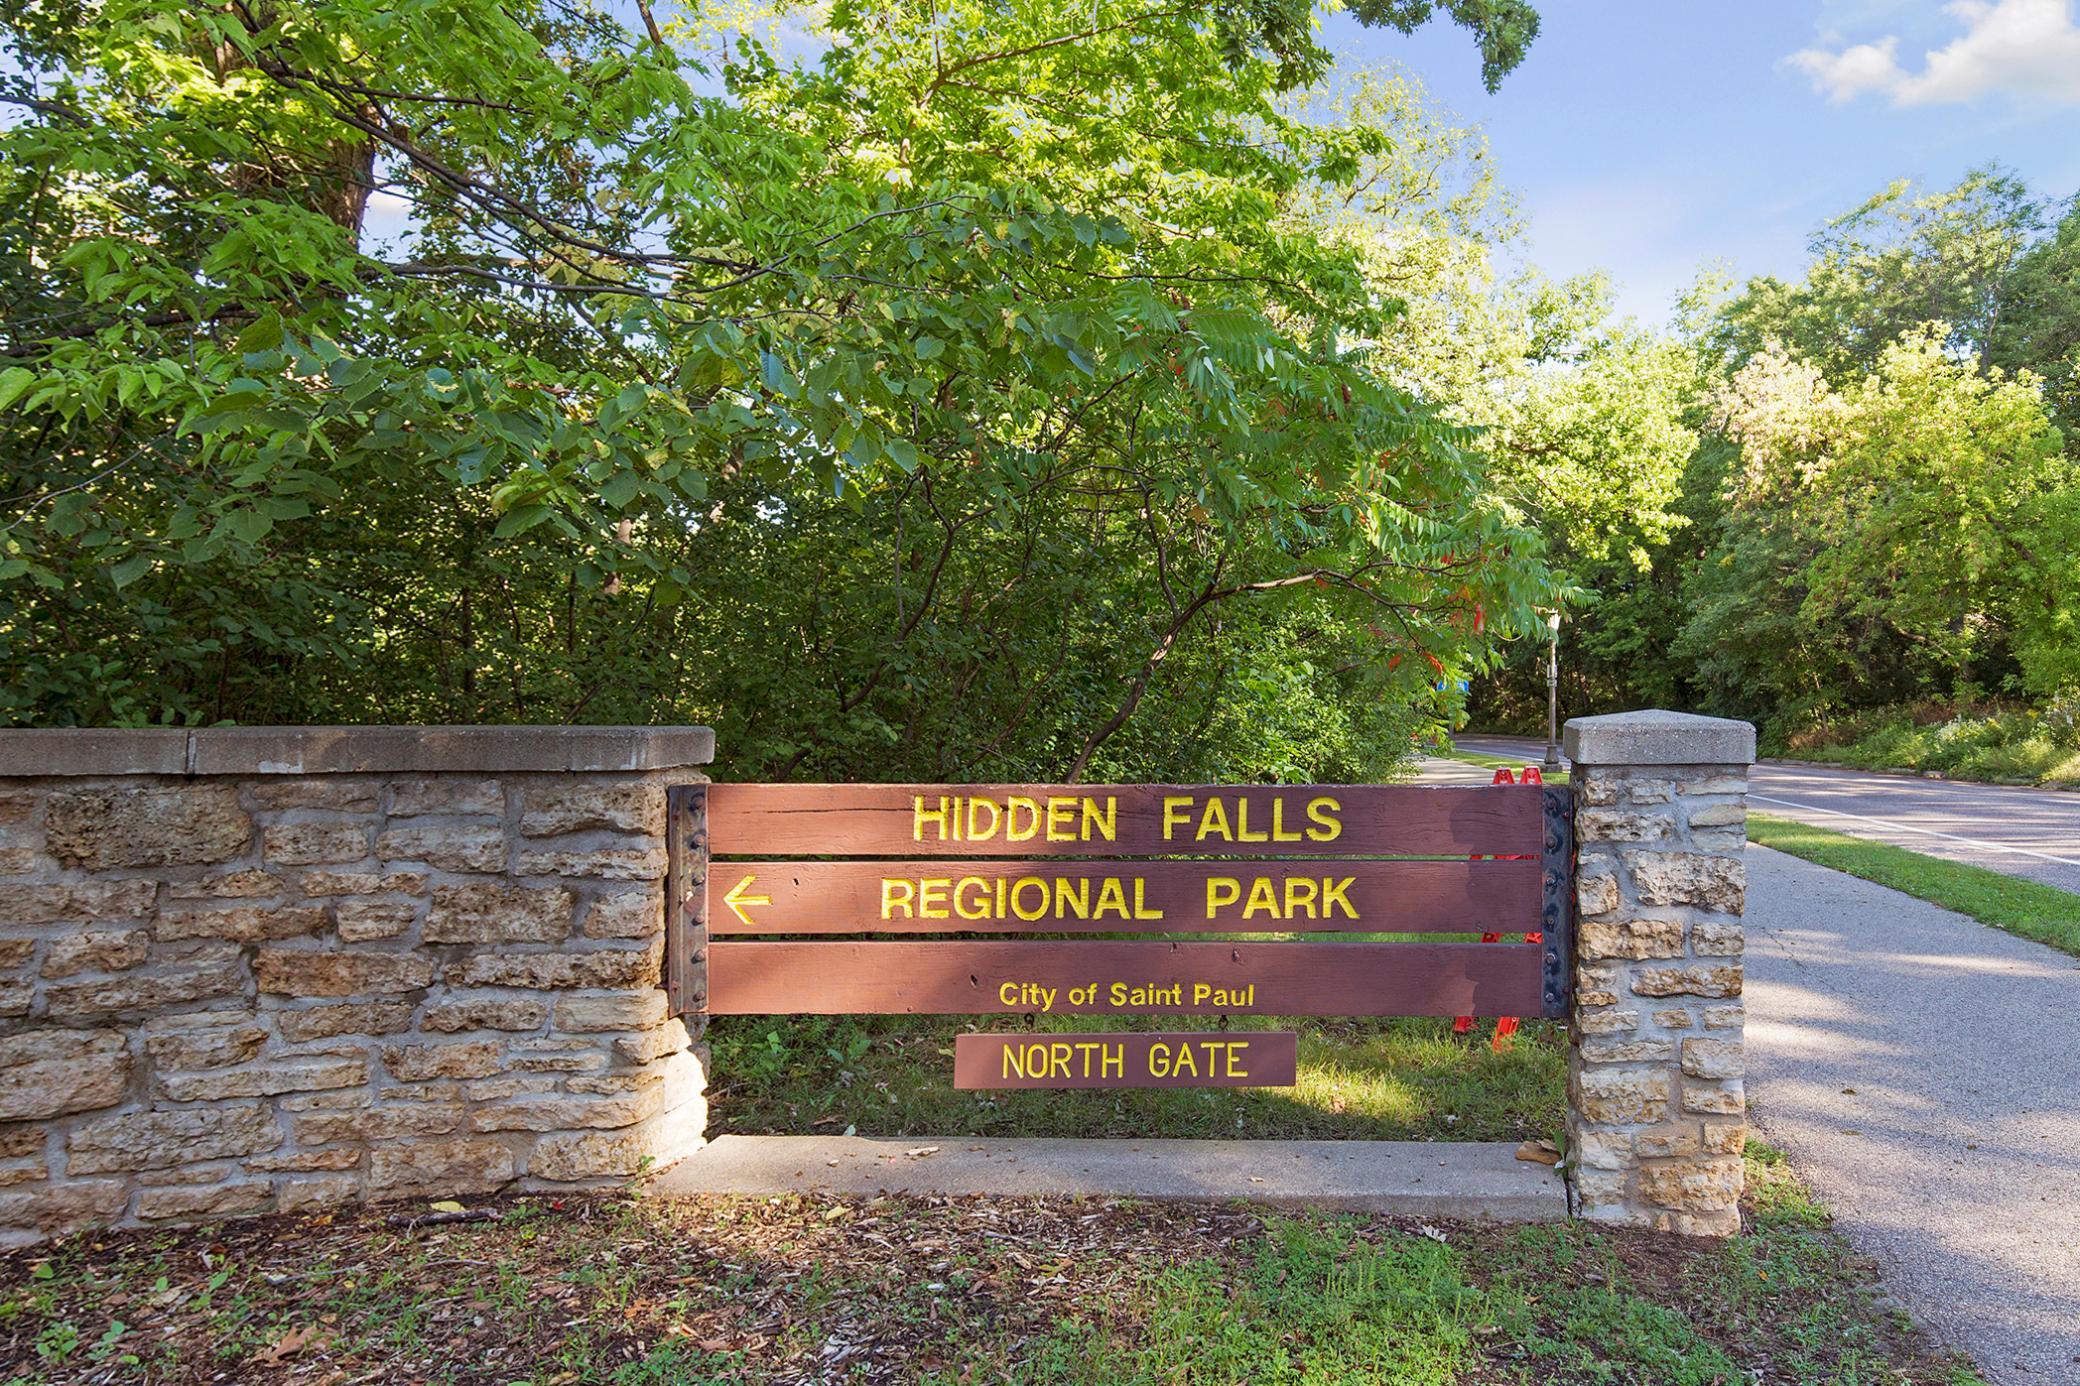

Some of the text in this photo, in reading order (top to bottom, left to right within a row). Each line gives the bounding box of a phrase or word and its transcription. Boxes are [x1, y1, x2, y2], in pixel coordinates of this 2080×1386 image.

[912, 796, 1343, 842] HIDDEN FALLS
[881, 876, 1359, 921] REGIONAL PARK
[999, 982, 1254, 1012] City of Saint Paul
[1003, 1042, 1249, 1078] NORTH GATE
